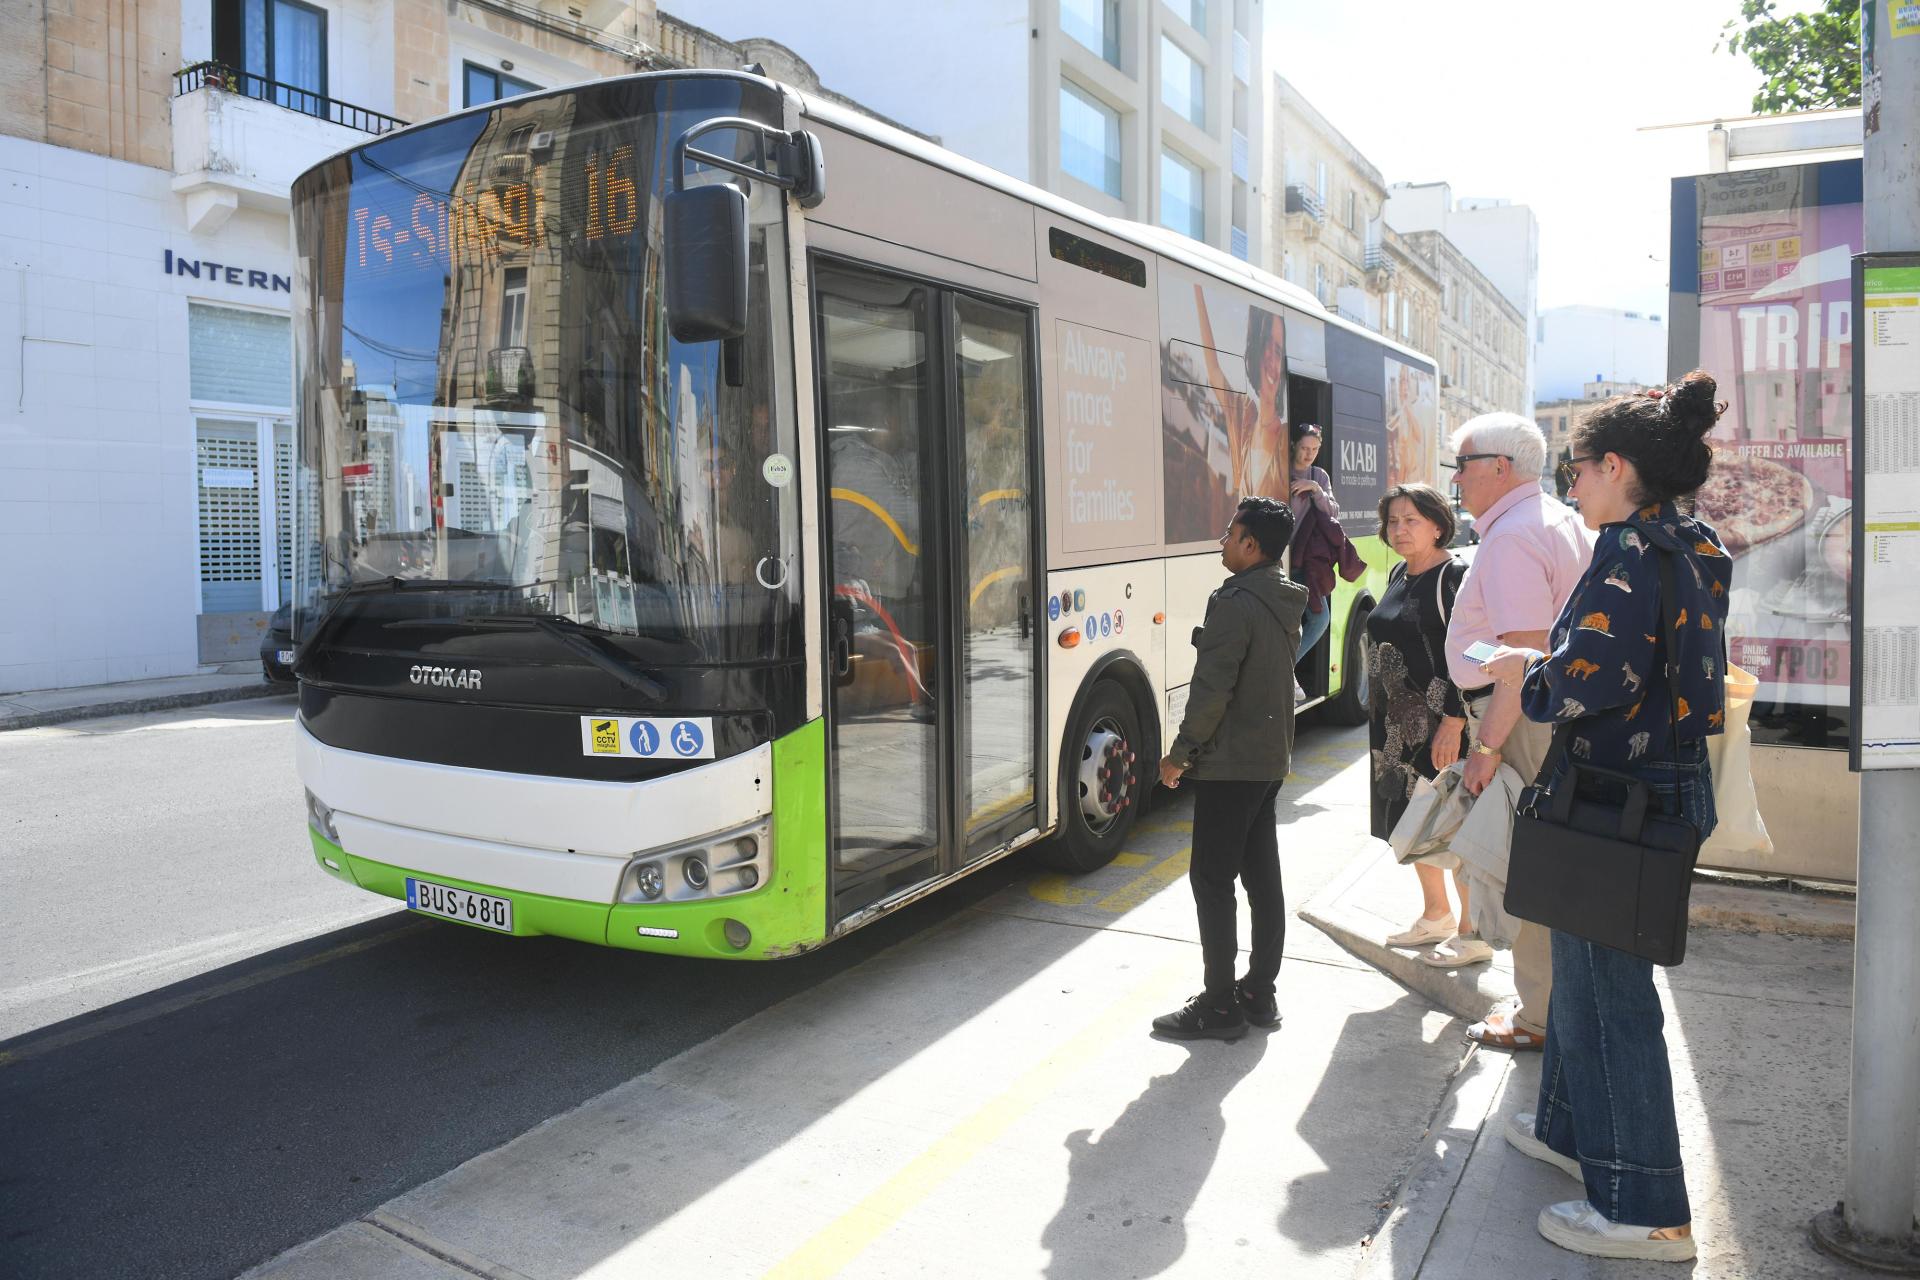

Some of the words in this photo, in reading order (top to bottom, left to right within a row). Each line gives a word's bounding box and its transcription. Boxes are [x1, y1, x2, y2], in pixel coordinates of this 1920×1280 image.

[584, 145, 637, 241] 16
[164, 249, 291, 294] INTERN
[1737, 300, 1852, 372] TRIP
[1063, 329, 1127, 390] Always
[1065, 389, 1113, 428] more
[1067, 428, 1095, 475] for
[1341, 440, 1377, 473] KIABI
[1738, 445, 1771, 459] OFFER
[1773, 445, 1785, 459] IS
[1786, 443, 1844, 459] AVAILABLE
[1068, 477, 1137, 524] families
[1125, 583, 1132, 600] C
[1742, 644, 1769, 656] ONLINE
[1742, 655, 1771, 666] COUPON
[409, 665, 482, 690] OTOKAR
[596, 736, 616, 744] CCTV
[419, 884, 458, 915] BUS
[466, 894, 505, 927] 680
